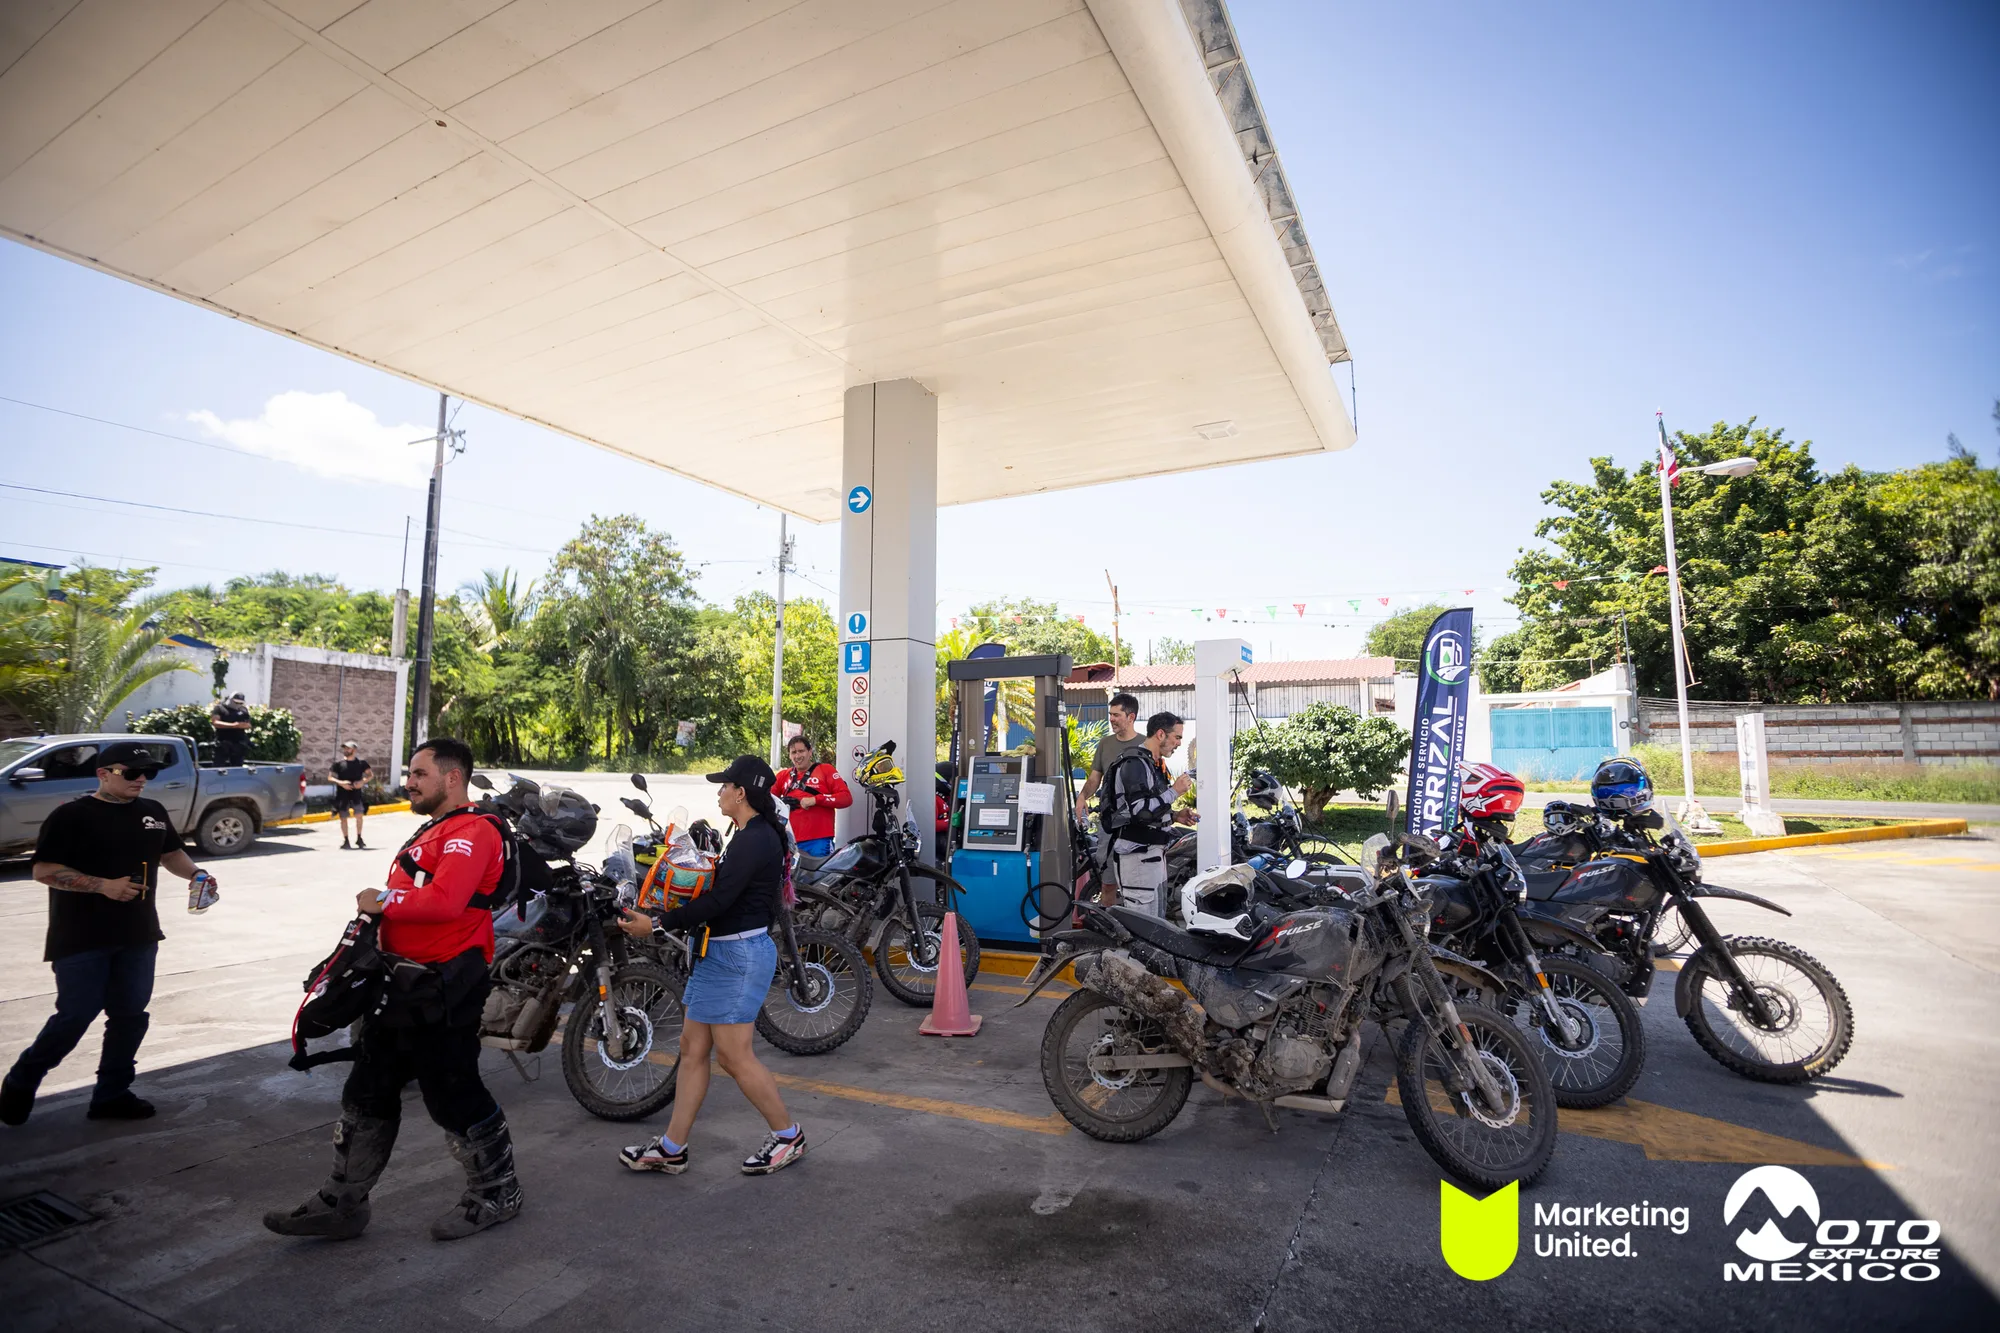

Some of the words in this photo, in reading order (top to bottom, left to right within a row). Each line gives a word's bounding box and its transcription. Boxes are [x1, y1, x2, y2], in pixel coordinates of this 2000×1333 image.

[1417, 718, 1430, 769] SERVICIO
[1456, 716, 1465, 752] MUEVE
[1416, 773, 1425, 787] DE
[1422, 695, 1453, 841] ARRIZAL
[1453, 756, 1461, 777] NOS
[1450, 781, 1459, 803] QUE
[1412, 790, 1423, 836] STACIÓN
[443, 838, 474, 854] GS
[1561, 864, 1617, 888] XPULSE
[1255, 919, 1324, 949] XPULSE
